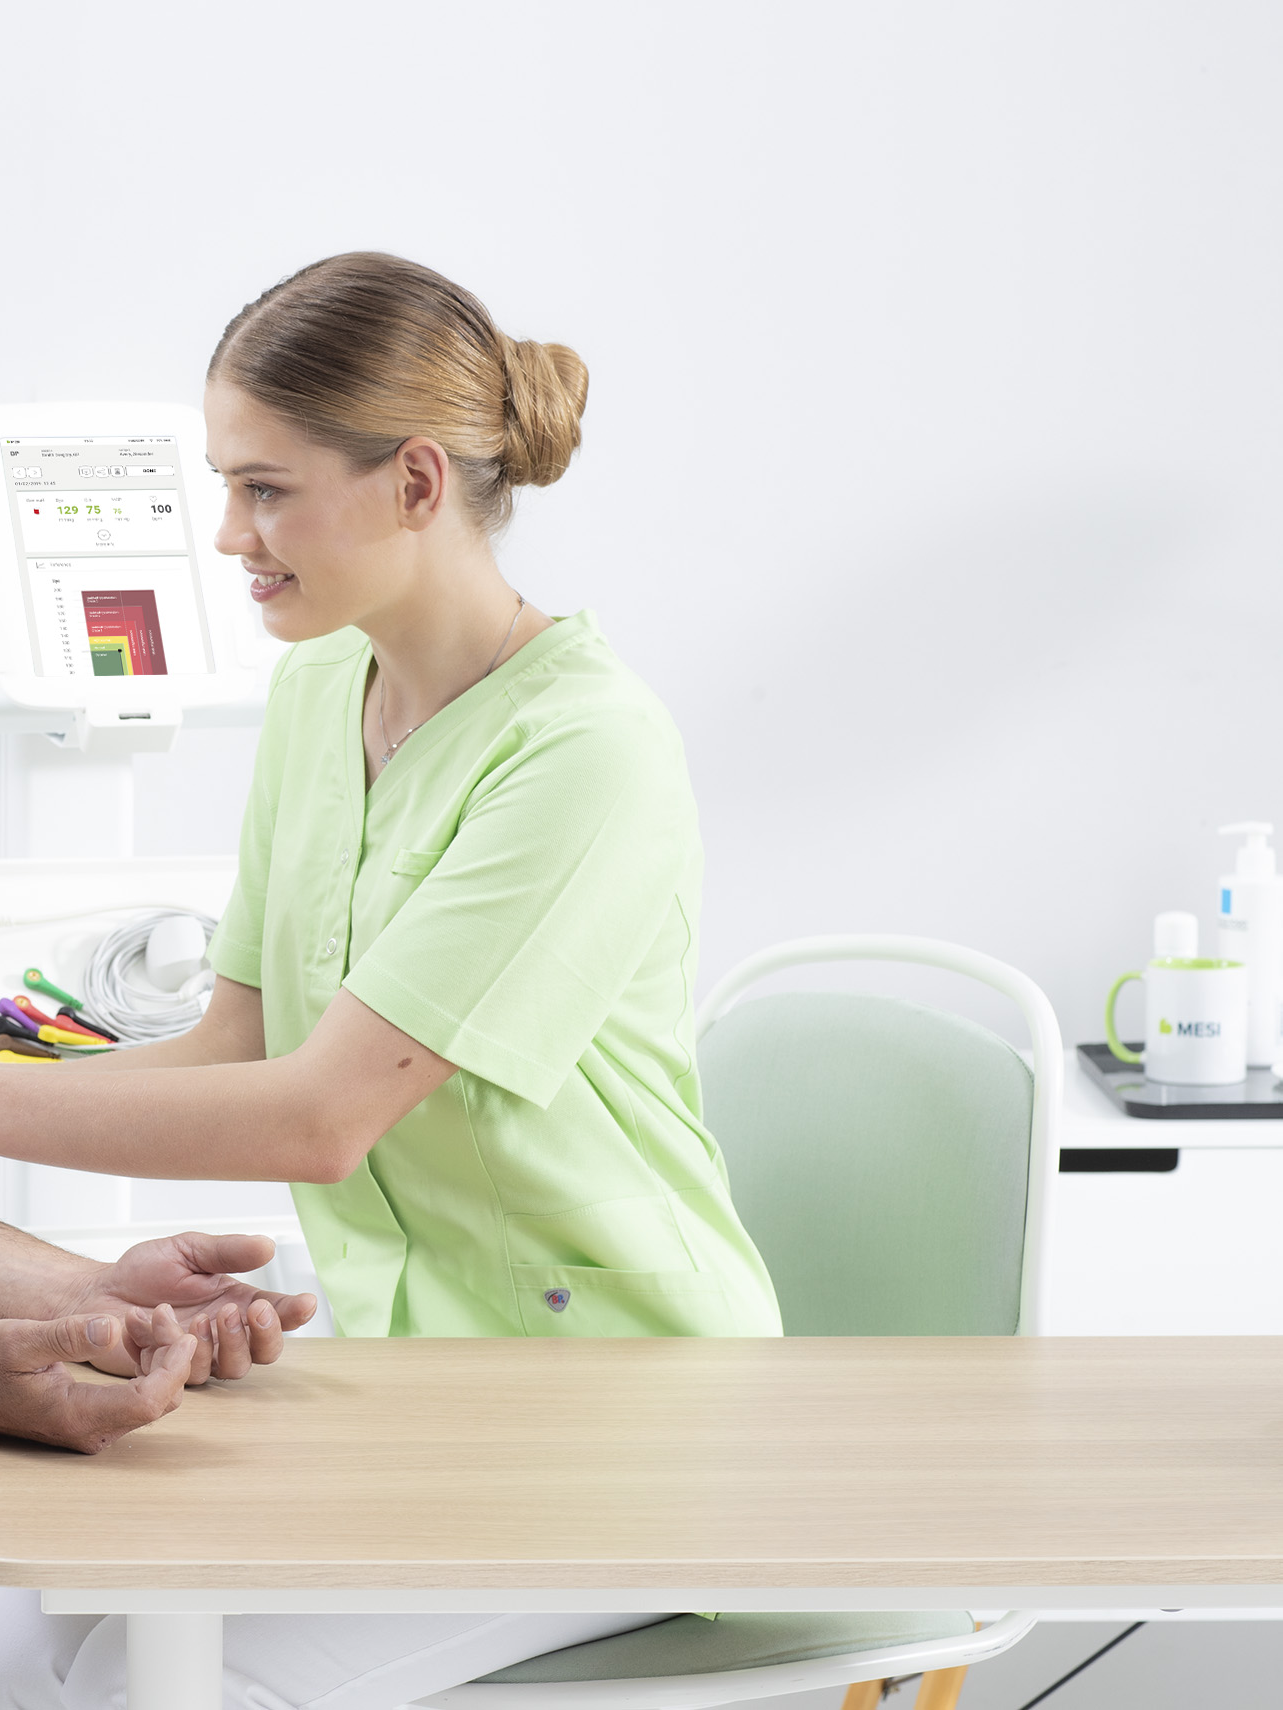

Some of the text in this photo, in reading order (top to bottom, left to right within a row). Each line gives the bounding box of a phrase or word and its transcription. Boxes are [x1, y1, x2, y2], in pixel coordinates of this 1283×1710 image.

[57, 506, 79, 514] 129
[86, 505, 101, 514] 75
[151, 505, 172, 513] 100
[1177, 1021, 1221, 1037] MESI
